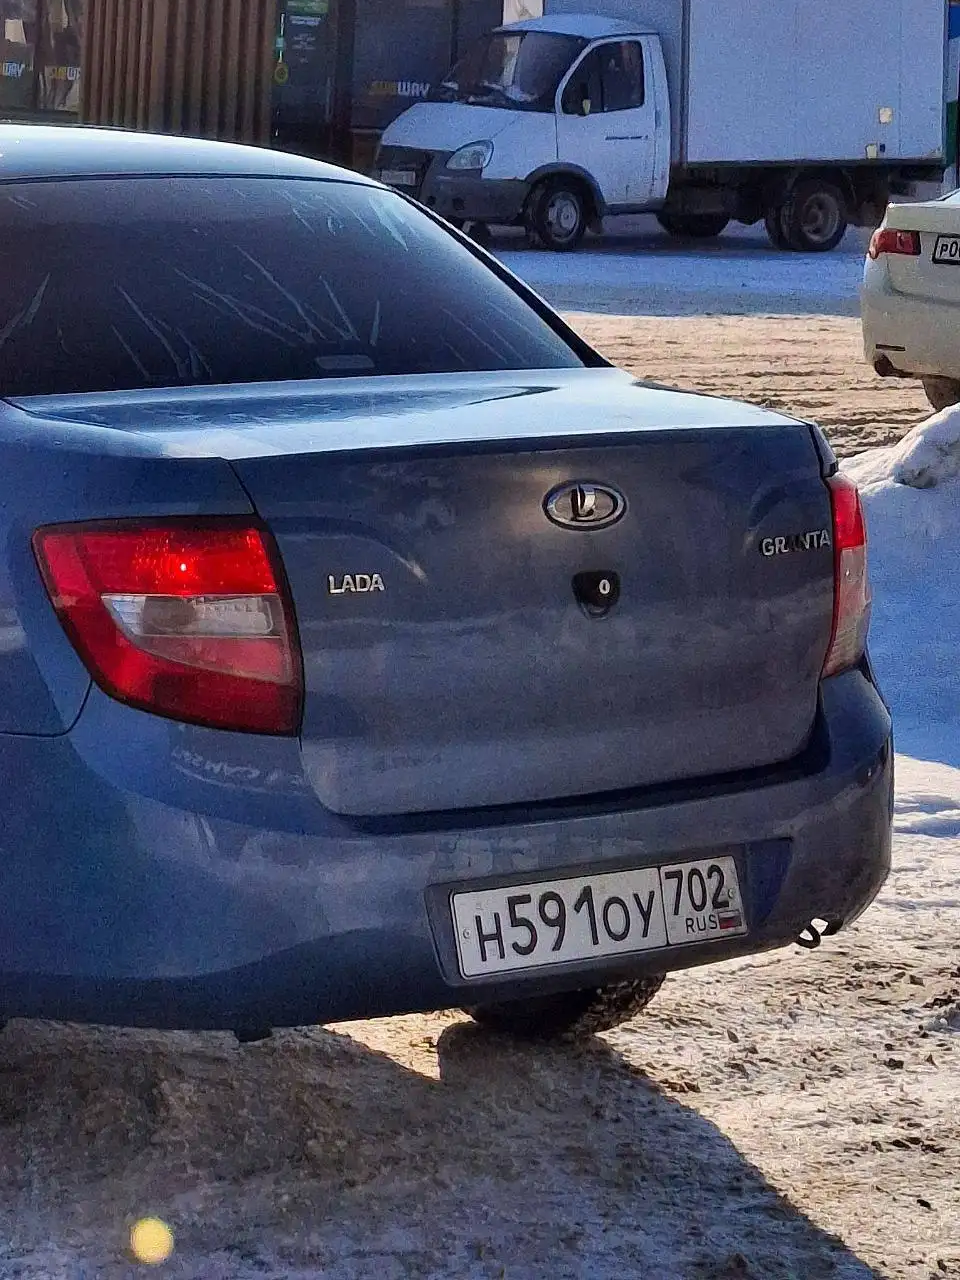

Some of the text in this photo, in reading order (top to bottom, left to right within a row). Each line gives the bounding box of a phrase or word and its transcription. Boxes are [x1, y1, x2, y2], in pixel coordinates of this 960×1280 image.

[761, 529, 832, 556] GRANTA
[327, 573, 386, 594] LADA
[665, 863, 730, 916] 702
[685, 914, 718, 935] RUS
